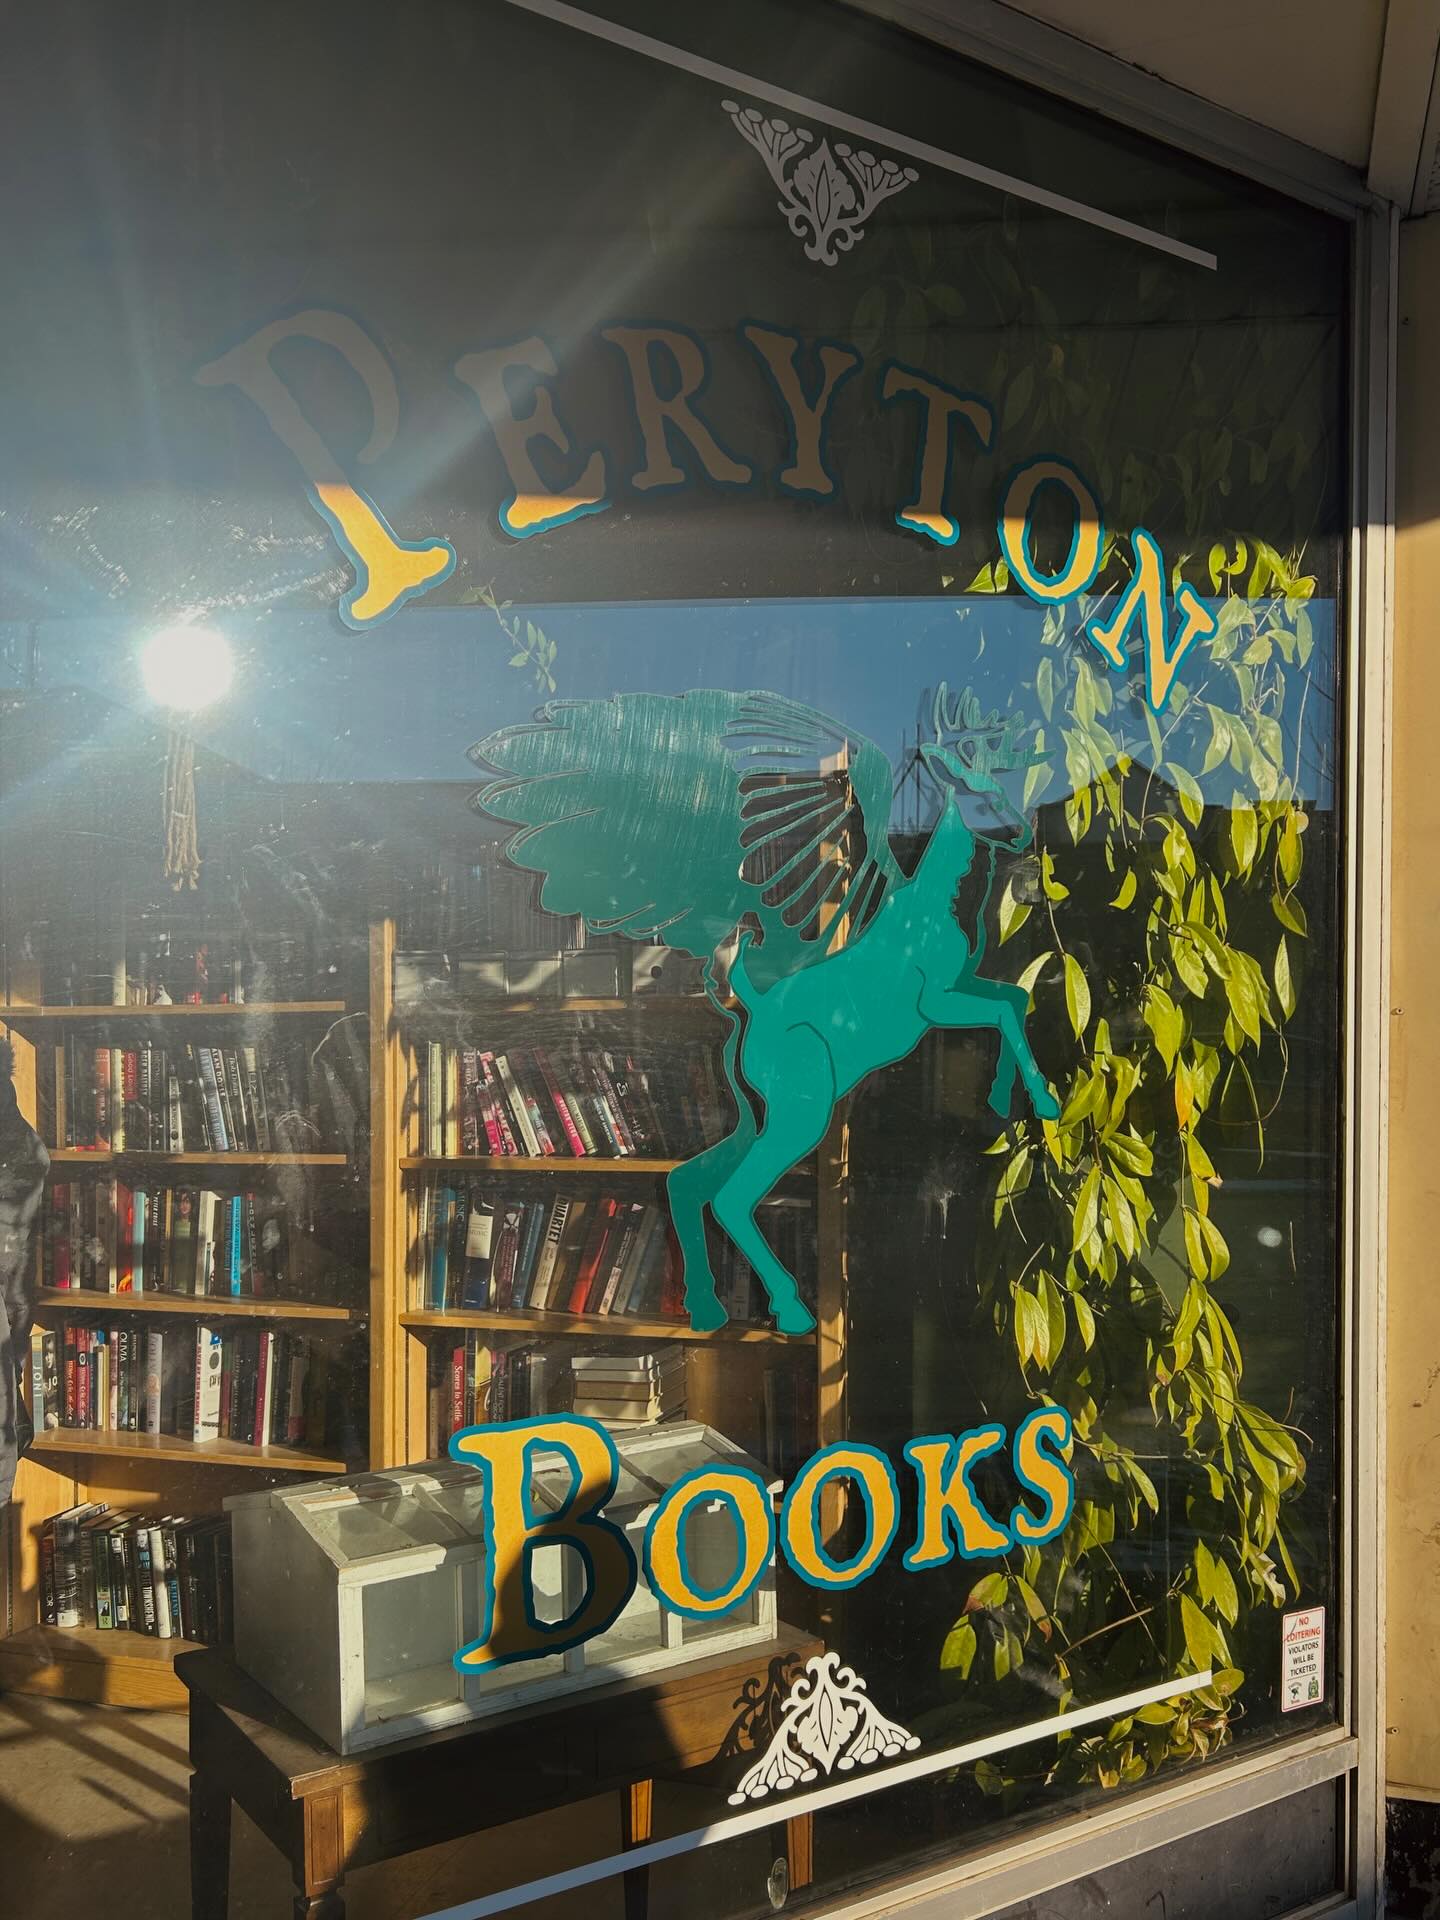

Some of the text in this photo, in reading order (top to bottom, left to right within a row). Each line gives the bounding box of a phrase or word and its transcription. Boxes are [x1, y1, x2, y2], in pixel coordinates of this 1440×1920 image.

[191, 306, 1216, 716] PERYTON
[455, 1189, 465, 1222] MUSIC
[547, 1198, 568, 1246] QUARTET
[119, 1331, 128, 1363] OLIVIA
[33, 1365, 43, 1398] JONI
[453, 1365, 464, 1422] Scores to Settle
[449, 1404, 1076, 1676] BOOKS
[1286, 1626, 1321, 1642] LOITERING
[1298, 1616, 1309, 1625] NO
[1288, 1641, 1319, 1655] VIOLATORS
[1293, 1655, 1306, 1665] WILL
[1290, 1664, 1317, 1677] TICKETED
